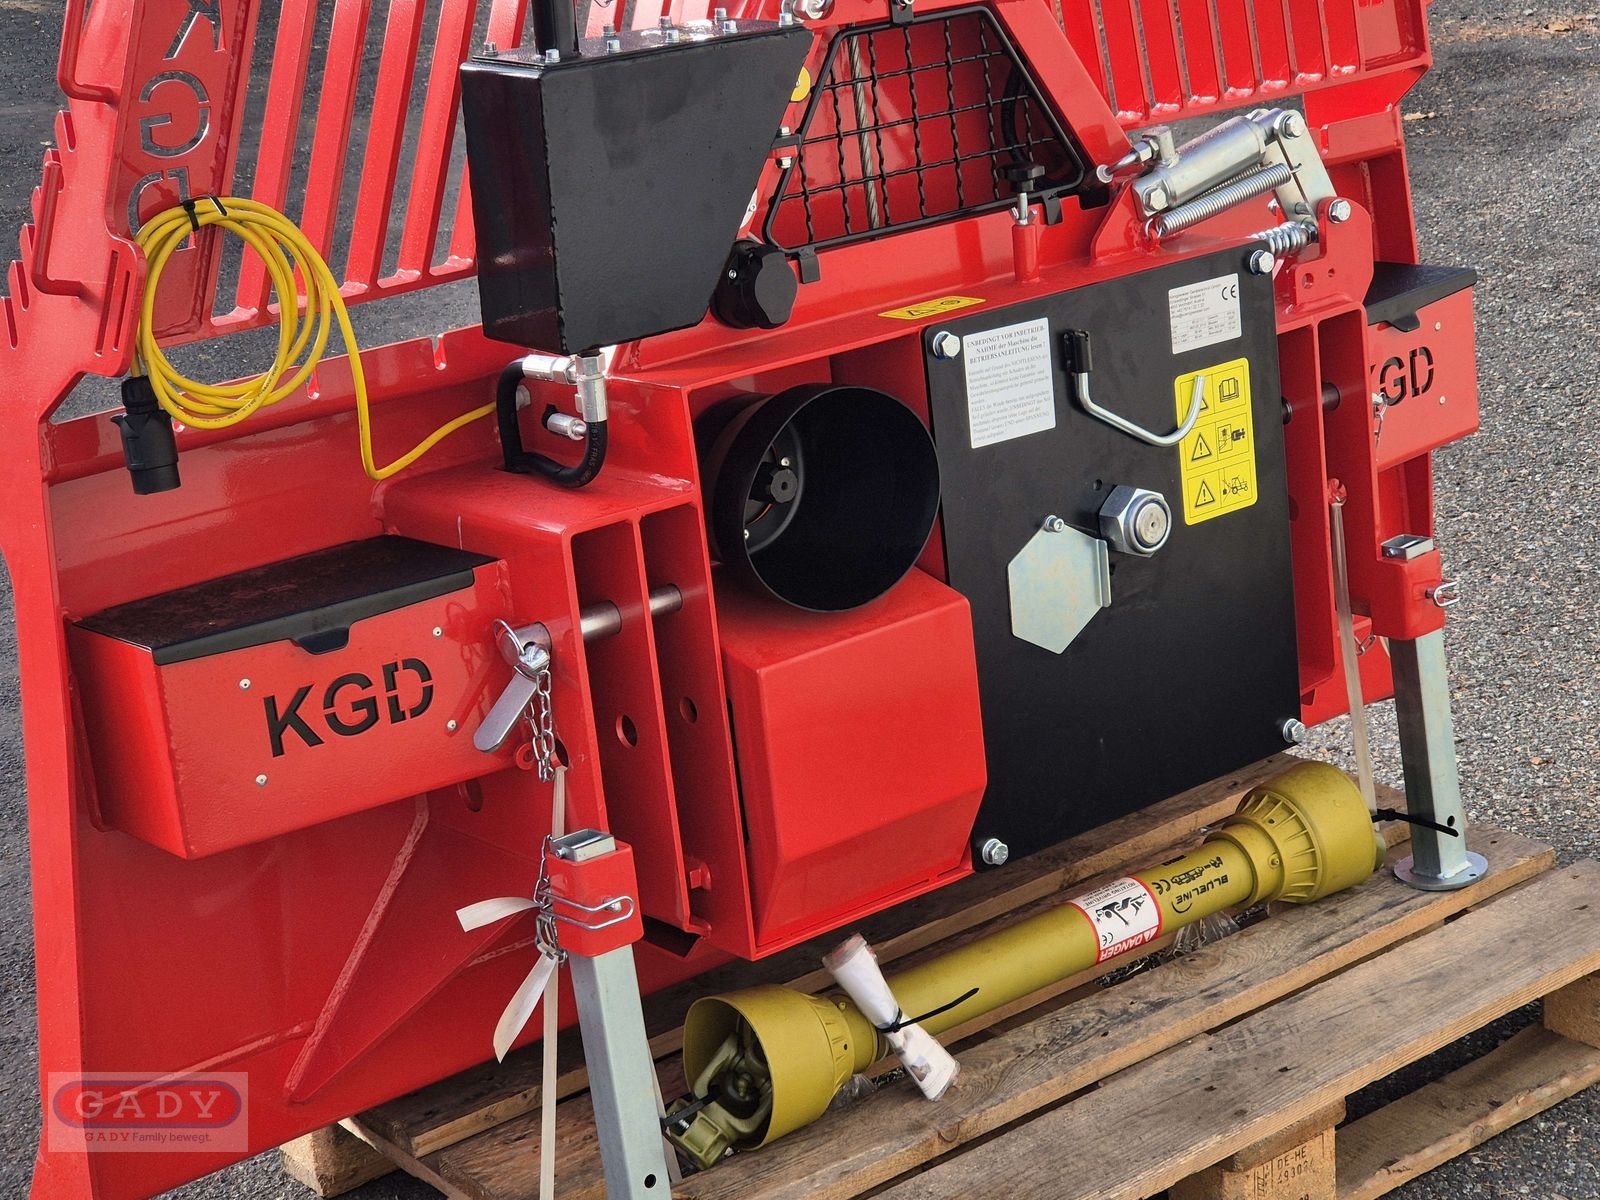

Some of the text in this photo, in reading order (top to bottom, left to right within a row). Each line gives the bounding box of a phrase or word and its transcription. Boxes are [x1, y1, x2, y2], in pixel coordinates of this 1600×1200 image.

[1370, 346, 1434, 407] GD
[263, 658, 434, 758] KGD
[1176, 874, 1229, 905] BLUELINE
[1100, 936, 1146, 962] DANGER
